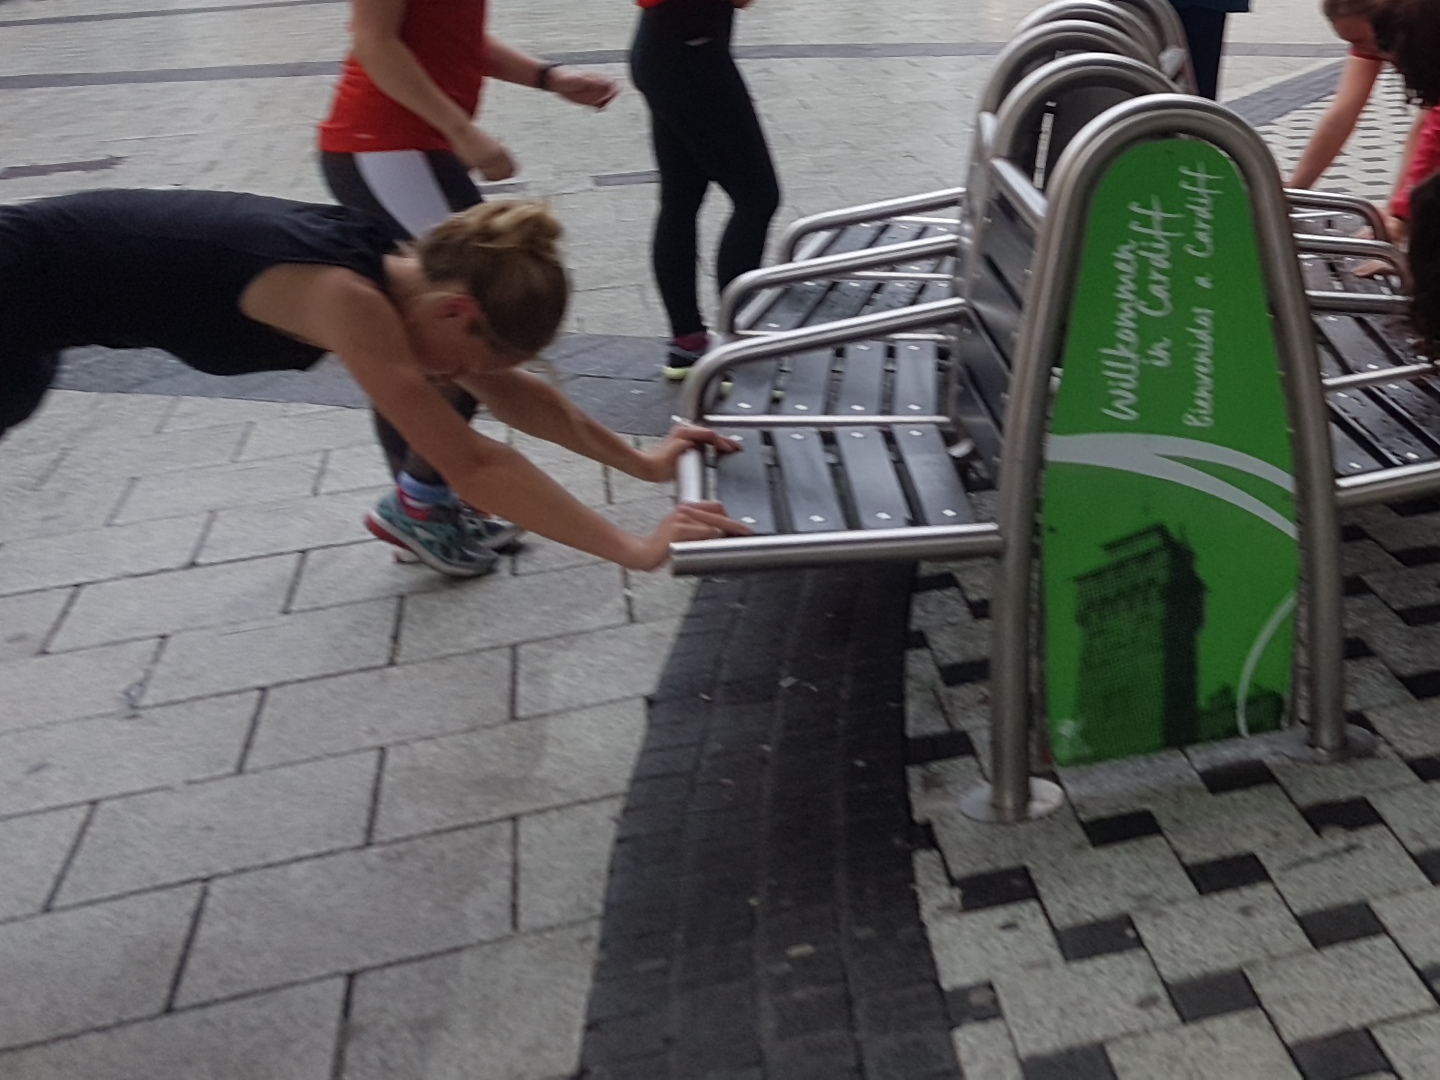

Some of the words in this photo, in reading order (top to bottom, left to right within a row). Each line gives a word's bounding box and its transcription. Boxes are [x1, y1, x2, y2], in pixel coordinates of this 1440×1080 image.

[1128, 194, 1186, 318] Cardiff
[1178, 162, 1225, 258] Cardiff
[1098, 239, 1140, 421] Willkommen
[1195, 273, 1213, 289] a
[1141, 335, 1172, 367] in
[1182, 307, 1214, 428] Bienvenidos
